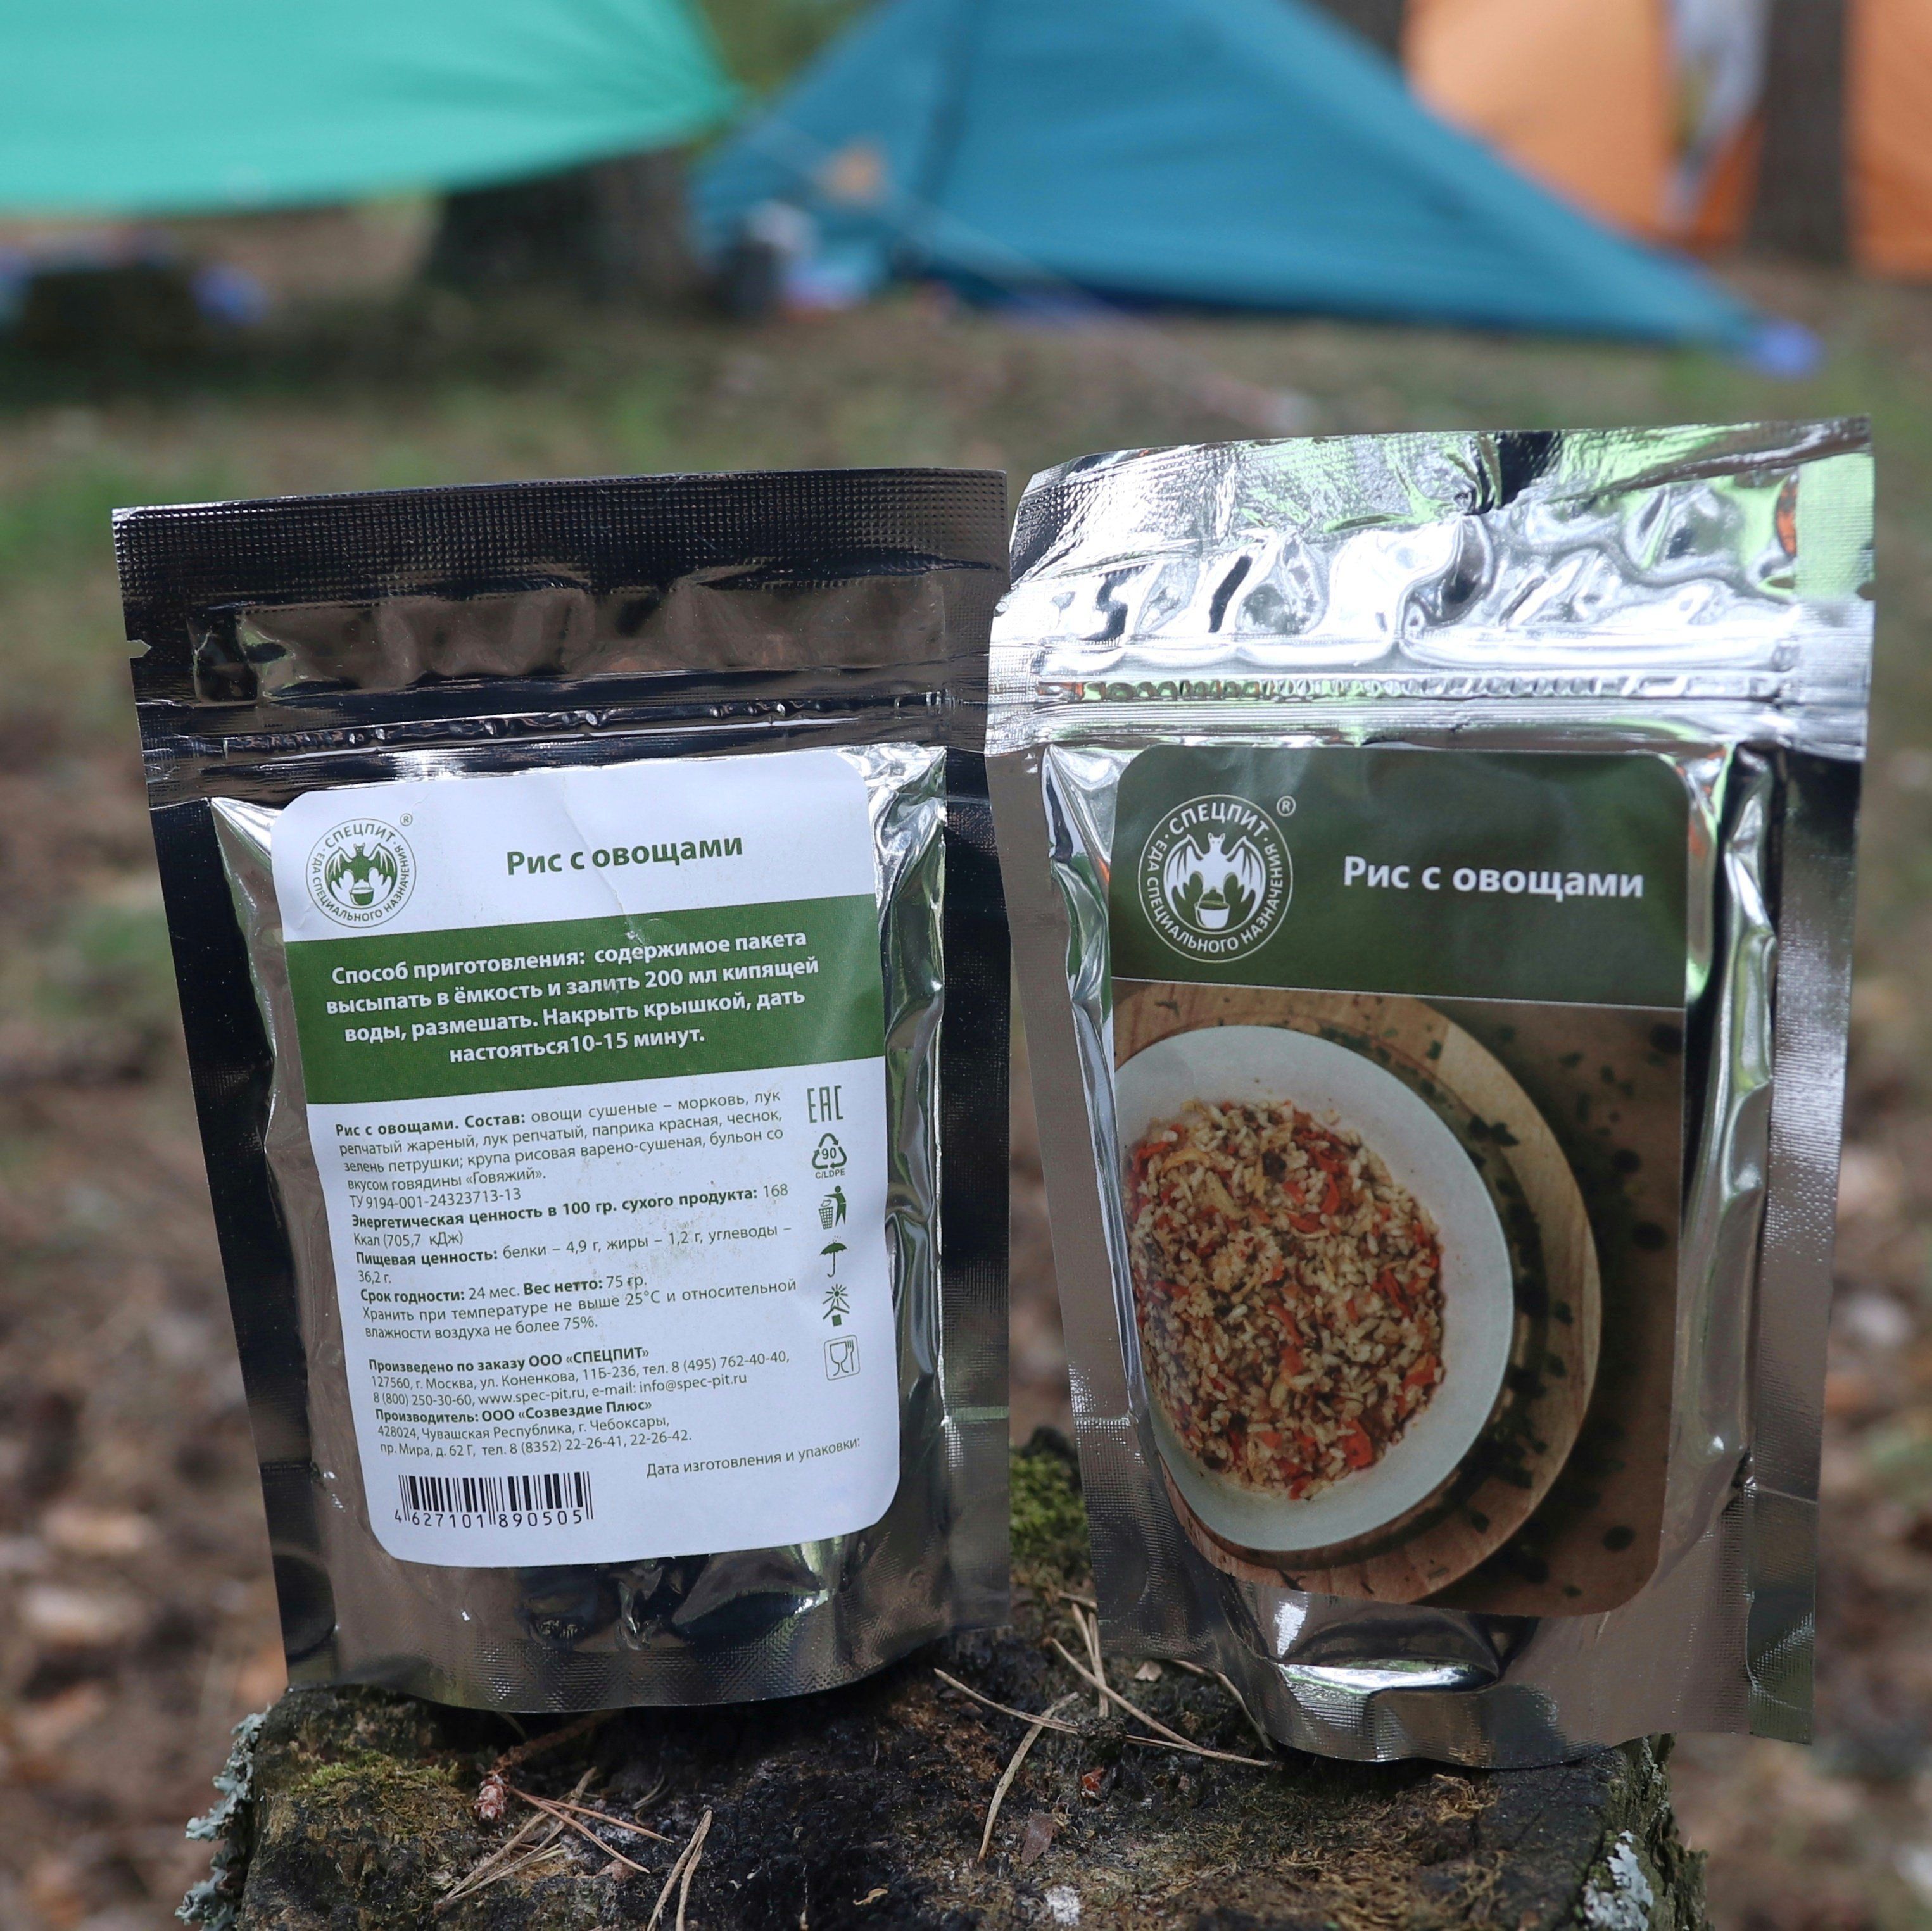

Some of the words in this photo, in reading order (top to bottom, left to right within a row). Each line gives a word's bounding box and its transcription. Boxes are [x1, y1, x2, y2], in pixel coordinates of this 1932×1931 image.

[324, 823, 396, 848] СПЕЦПИТ
[1168, 802, 1270, 835] СПЕЦПИТ
[312, 852, 325, 874] ЕДА
[507, 851, 563, 876] Рис
[570, 851, 585, 871] с
[591, 837, 743, 868] овощами
[1147, 840, 1168, 872] ЕДА
[383, 845, 410, 912] НАЗНАЧЕНИЯ
[1240, 843, 1284, 945] НАЗНАЧЕНИЯ
[1344, 855, 1410, 889] Рис
[1422, 866, 1441, 890] с
[1453, 867, 1643, 902] овощами
[313, 877, 382, 922] СПЕЦИАЛЬНОГО
[1147, 877, 1239, 953] СПЕЦИАЛЬНОГО
[332, 960, 408, 984] Способ
[414, 951, 585, 982] приготовления:
[594, 937, 730, 965] содержимое
[735, 933, 807, 951] пакета
[326, 994, 432, 1014] высыпать
[437, 992, 450, 1006] в
[454, 985, 543, 1004] ёмкость
[548, 983, 561, 997] и
[566, 976, 640, 995] залить
[645, 969, 683, 988] 200
[688, 969, 717, 984] мл
[723, 955, 819, 981] кипящей
[344, 1026, 407, 1044] воды,
[412, 1015, 538, 1041] размешать.
[543, 1006, 639, 1027] Накрыть
[643, 991, 752, 1021] крышкой,
[756, 991, 805, 1011] дать
[633, 1029, 705, 1048] минут.
[335, 1124, 360, 1136] Рис
[365, 1126, 372, 1136] с
[377, 1120, 459, 1135] овощами.
[464, 1114, 526, 1128] Состав:
[531, 1109, 582, 1123] овощи
[588, 1102, 657, 1121] сушеные
[678, 1095, 748, 1112] морковь,
[754, 1091, 781, 1106] лук
[339, 1140, 402, 1157] репчатый
[407, 1134, 479, 1154] жареный,
[483, 1135, 508, 1148] лук
[512, 1125, 588, 1147] репчатый,
[592, 1122, 654, 1138] паприка
[659, 1116, 723, 1133] красная,
[727, 1110, 782, 1124] чеснок,
[343, 1162, 384, 1173] зелень
[388, 1157, 463, 1174] петрушки;
[467, 1153, 510, 1169] крупа
[515, 1147, 576, 1166] рисовая
[580, 1136, 706, 1159] варено-сушеная,
[710, 1131, 762, 1148] бульон
[766, 1129, 783, 1140] со
[821, 1147, 837, 1159] 90
[347, 1180, 388, 1193] вкусом
[391, 1176, 462, 1192] говядины
[465, 1167, 546, 1185] «Говяжий».
[815, 1168, 846, 1179] C/LDPE
[351, 1214, 464, 1231] Энергетическая
[469, 1208, 543, 1226] ценность
[548, 1206, 557, 1217] в
[562, 1201, 590, 1216] 100
[595, 1202, 617, 1216] гр.
[621, 1197, 674, 1214] сухого
[679, 1189, 758, 1209] продукта:
[763, 1183, 788, 1198] 168
[353, 1233, 380, 1246] Ккал
[383, 1233, 421, 1249] (705,7
[429, 1230, 463, 1247] кДж)
[356, 1251, 416, 1267] Пищевая
[420, 1250, 498, 1267] ценность:
[502, 1245, 546, 1259] белки
[565, 1239, 587, 1255] 4,9
[593, 1241, 602, 1253] г,
[606, 1237, 648, 1252] жиры
[669, 1231, 689, 1247] 1,2
[694, 1232, 703, 1244] г,
[708, 1226, 778, 1245] углеводы
[358, 1269, 381, 1285] 36,2
[384, 1274, 392, 1284] г.
[360, 1288, 392, 1305] Срок
[394, 1290, 465, 1305] годности:
[469, 1286, 486, 1300] 24
[489, 1286, 520, 1299] мес.
[523, 1282, 551, 1296] Вес
[554, 1280, 603, 1293] нетто:
[606, 1274, 623, 1288] 75
[627, 1276, 647, 1291] гр.
[362, 1306, 414, 1323] Хранить
[419, 1311, 446, 1324] при
[451, 1303, 548, 1320] температуре
[554, 1301, 572, 1312] не
[578, 1297, 620, 1310] выше
[667, 1292, 676, 1302] и
[681, 1278, 797, 1301] относительной
[365, 1327, 431, 1339] влажности
[434, 1326, 490, 1341] воздуха
[494, 1324, 512, 1336] не
[515, 1320, 560, 1334] более
[563, 1315, 598, 1330] 75%.
[369, 1359, 454, 1375] Произведено
[457, 1362, 474, 1372] по
[477, 1359, 526, 1371] заказу
[528, 1353, 562, 1368] ООО
[566, 1346, 649, 1364] «СПЕЦПИТ»
[372, 1376, 414, 1391] 127560,
[415, 1380, 424, 1390] г.
[426, 1378, 477, 1390] Москва,
[479, 1378, 499, 1392] ул.
[502, 1373, 579, 1387] Коненкова,
[583, 1364, 640, 1381] 11Б-236,
[642, 1364, 669, 1376] тел.
[671, 1361, 681, 1373] 8
[683, 1357, 717, 1374] (495)
[720, 1350, 790, 1369] 762-40-40,
[373, 1392, 381, 1404] 8
[381, 1392, 409, 1407] (800)
[412, 1392, 475, 1407] 250-30-60,
[477, 1389, 589, 1406] www.spec-pit.ru,
[591, 1381, 636, 1397] e-mail:
[640, 1374, 748, 1393] info@spec-pit.ru
[375, 1408, 479, 1425] Производитель:
[481, 1409, 515, 1422] ООО
[518, 1405, 603, 1419] «Созвездие
[606, 1401, 652, 1413] Плюс»
[377, 1425, 419, 1440] 428024,
[422, 1428, 490, 1442] Чувашская
[493, 1423, 575, 1440] Республика,
[579, 1423, 587, 1433] г.
[590, 1416, 669, 1431] Чебоксары,
[380, 1444, 397, 1456] пр.
[398, 1442, 433, 1458] Мира,
[436, 1447, 446, 1459] д.
[449, 1444, 464, 1456] 62
[481, 1446, 507, 1456] тел.
[510, 1442, 518, 1454] 8
[521, 1440, 562, 1455] (8352)
[565, 1435, 627, 1450] 22-26-41,
[630, 1429, 692, 1446] 22-26-42.
[646, 1462, 679, 1479] Дата
[683, 1453, 782, 1473] изготовления
[786, 1452, 795, 1462] и
[797, 1438, 860, 1464] упаковки:
